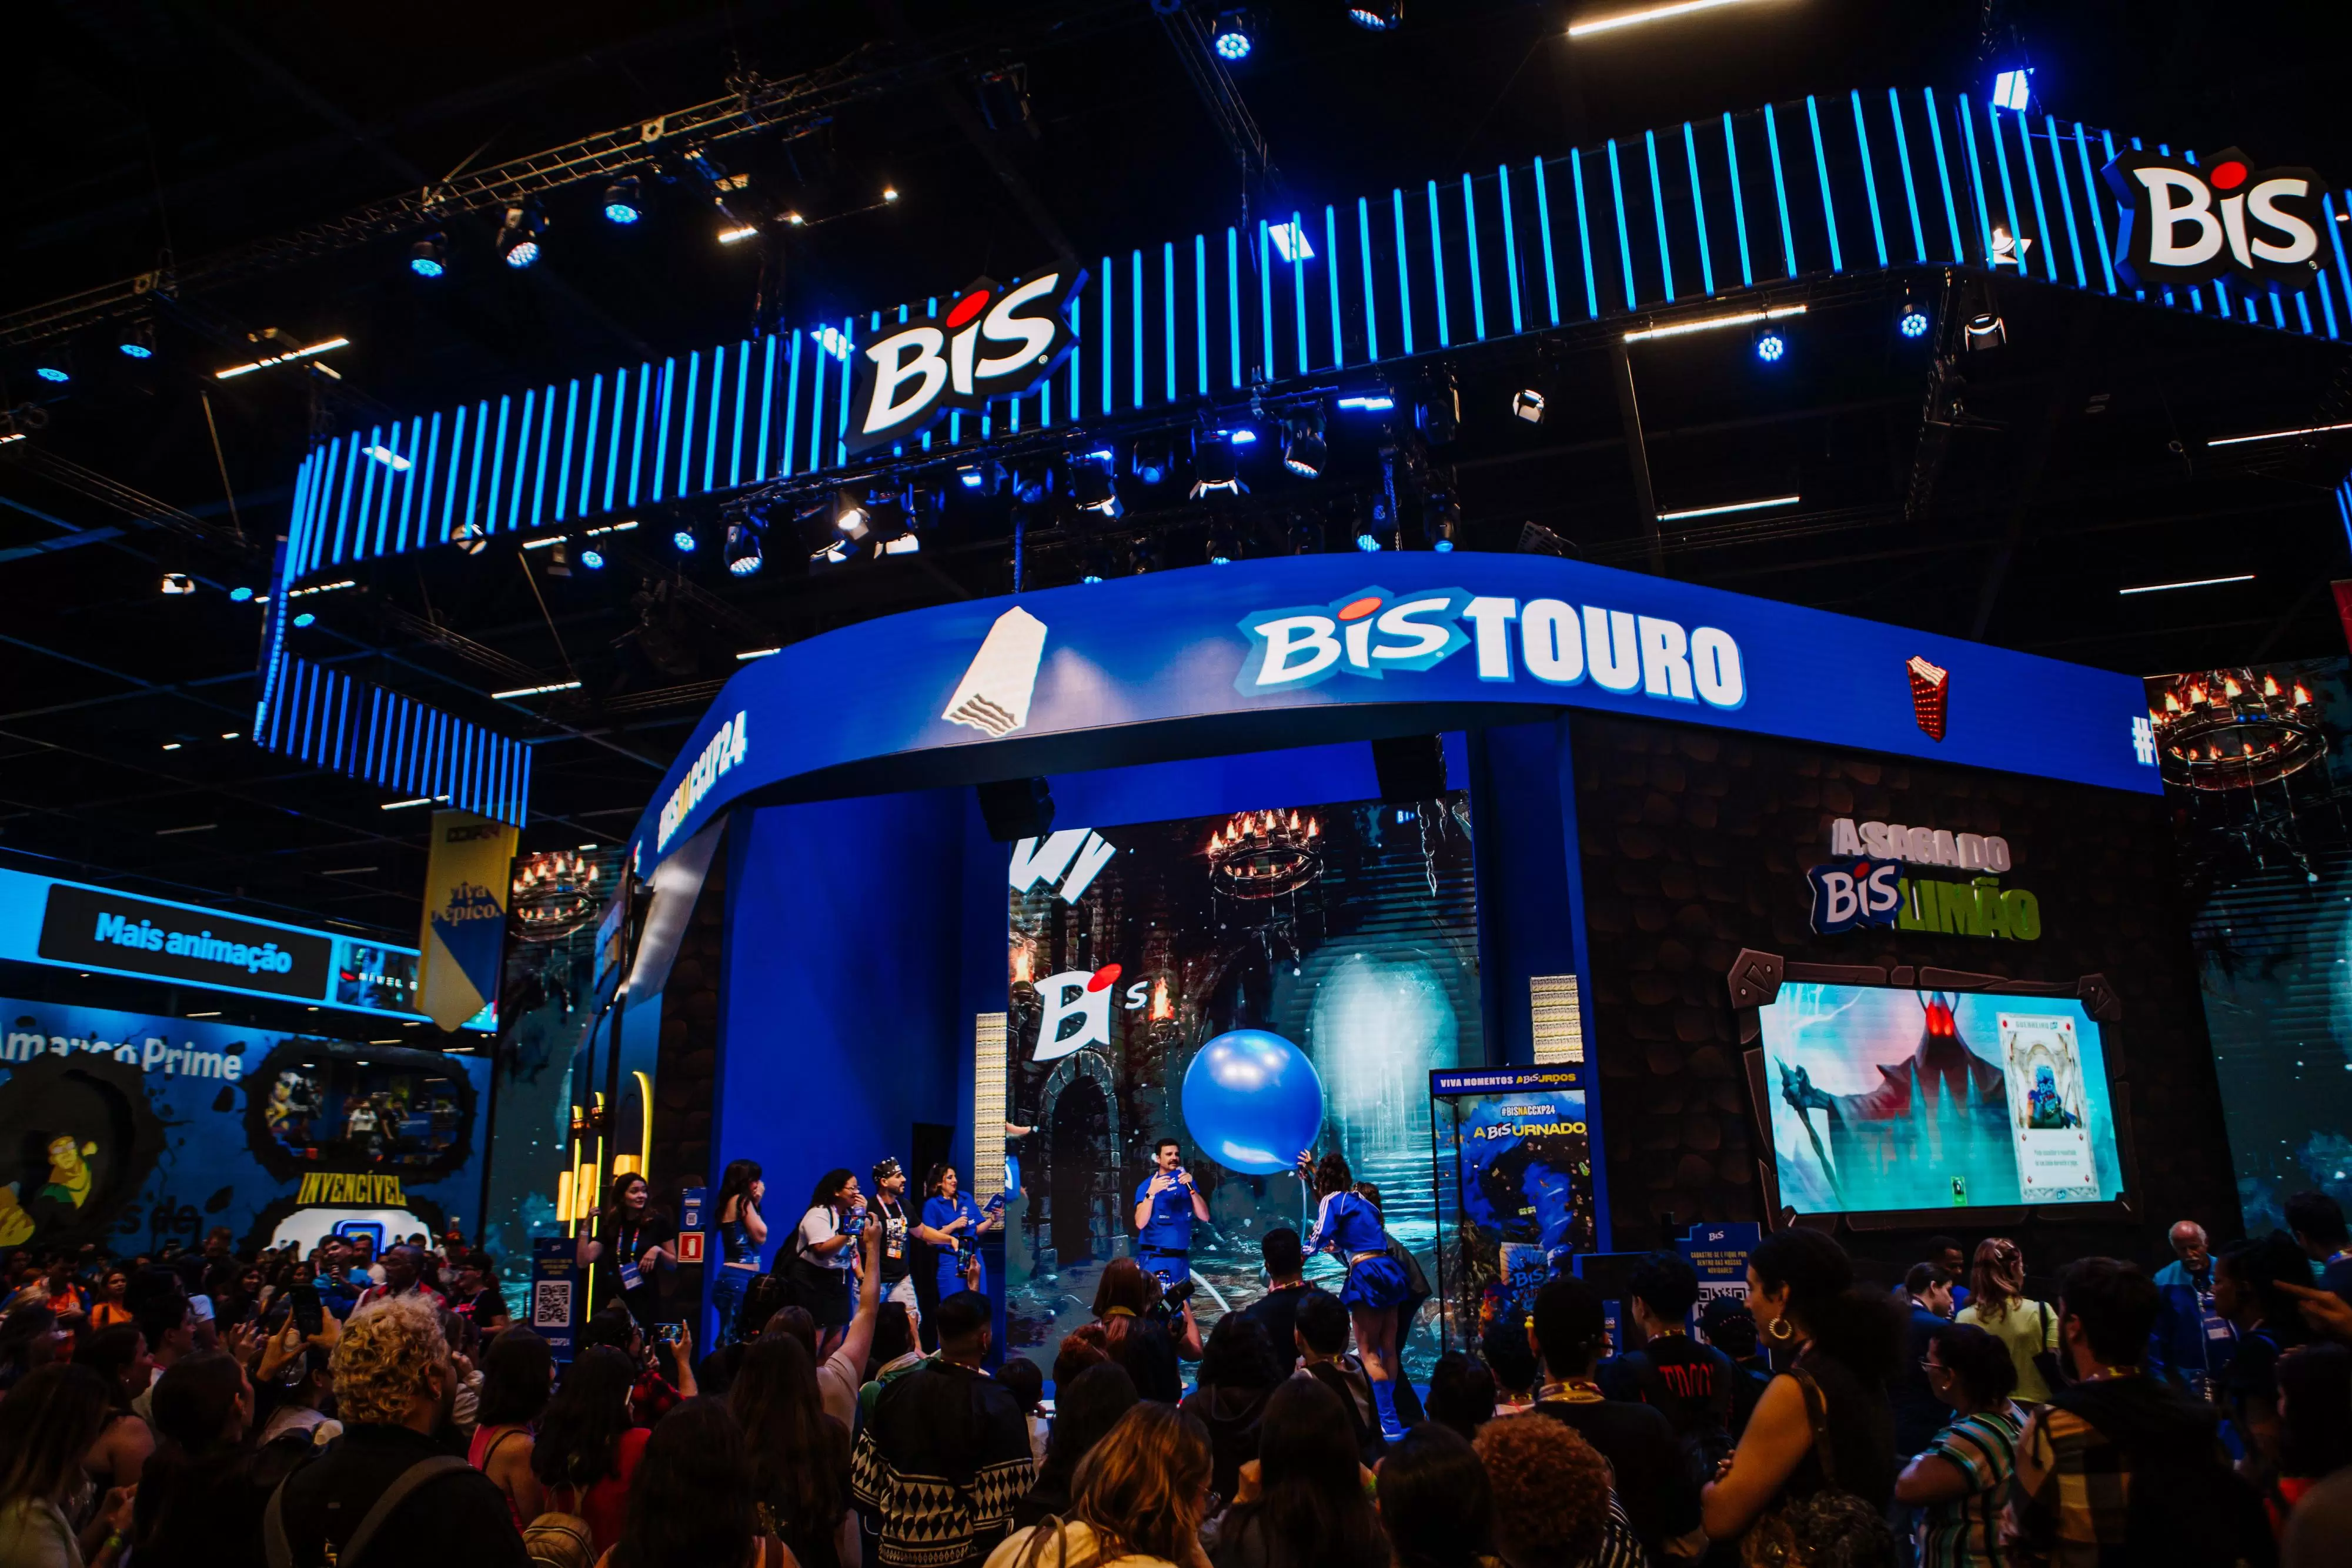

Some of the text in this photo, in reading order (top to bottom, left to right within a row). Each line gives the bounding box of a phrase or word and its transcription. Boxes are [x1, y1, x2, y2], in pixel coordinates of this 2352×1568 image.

[1898, 876, 2042, 941] LIMÃO
[94, 912, 292, 974] Mais animação
[142, 1037, 243, 1081] Prime
[1441, 1079, 1462, 1088] VIVA
[1464, 1076, 1514, 1086] MOMENTOS
[1501, 1105, 1556, 1117] #BISNACCXP24
[296, 1169, 409, 1206] INVENCÍVEL
